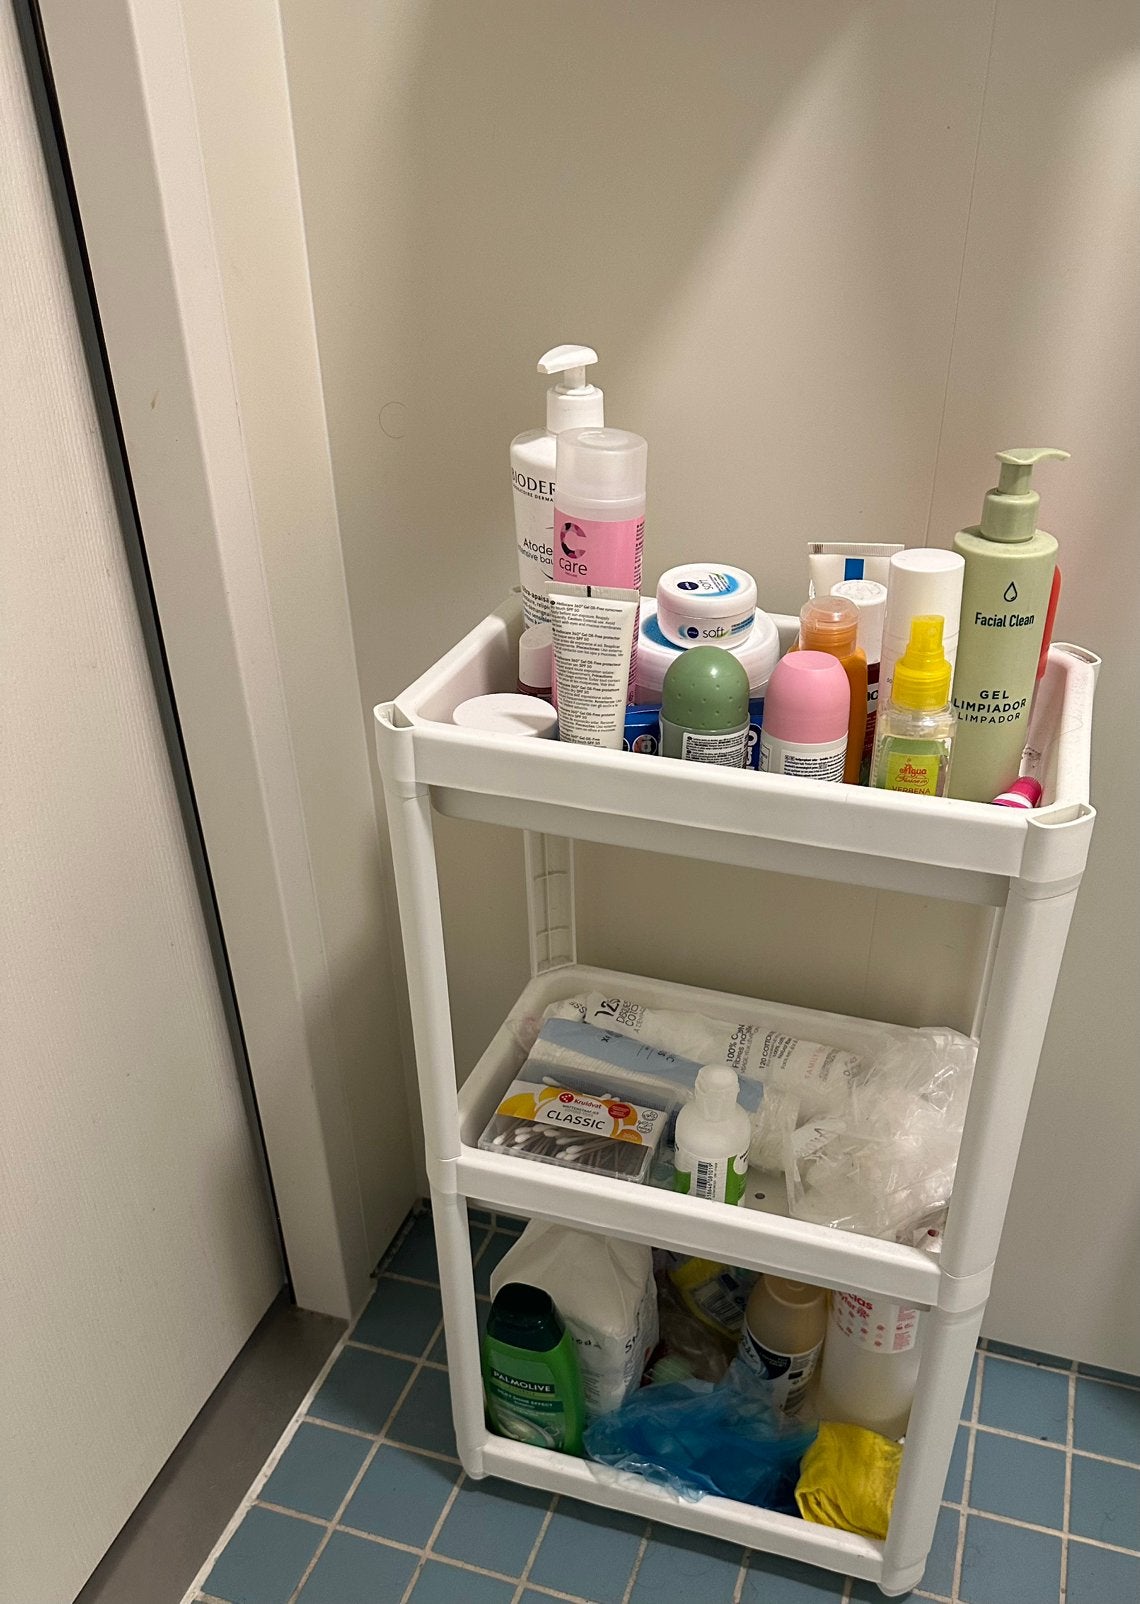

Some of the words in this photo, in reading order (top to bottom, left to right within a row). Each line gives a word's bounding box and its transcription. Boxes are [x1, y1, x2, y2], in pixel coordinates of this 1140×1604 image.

[559, 557, 588, 576] care
[975, 612, 1006, 628] Facial
[1008, 614, 1035, 628] Clean
[702, 626, 727, 639] soft
[980, 690, 1010, 700] GEL
[953, 698, 1026, 713] LIMPIADOR
[958, 712, 1020, 724] LIMPADOR
[574, 1098, 602, 1110] Kruidvat
[546, 1110, 606, 1130] CLASSIC
[493, 1370, 552, 1392] PALMOLIVE
